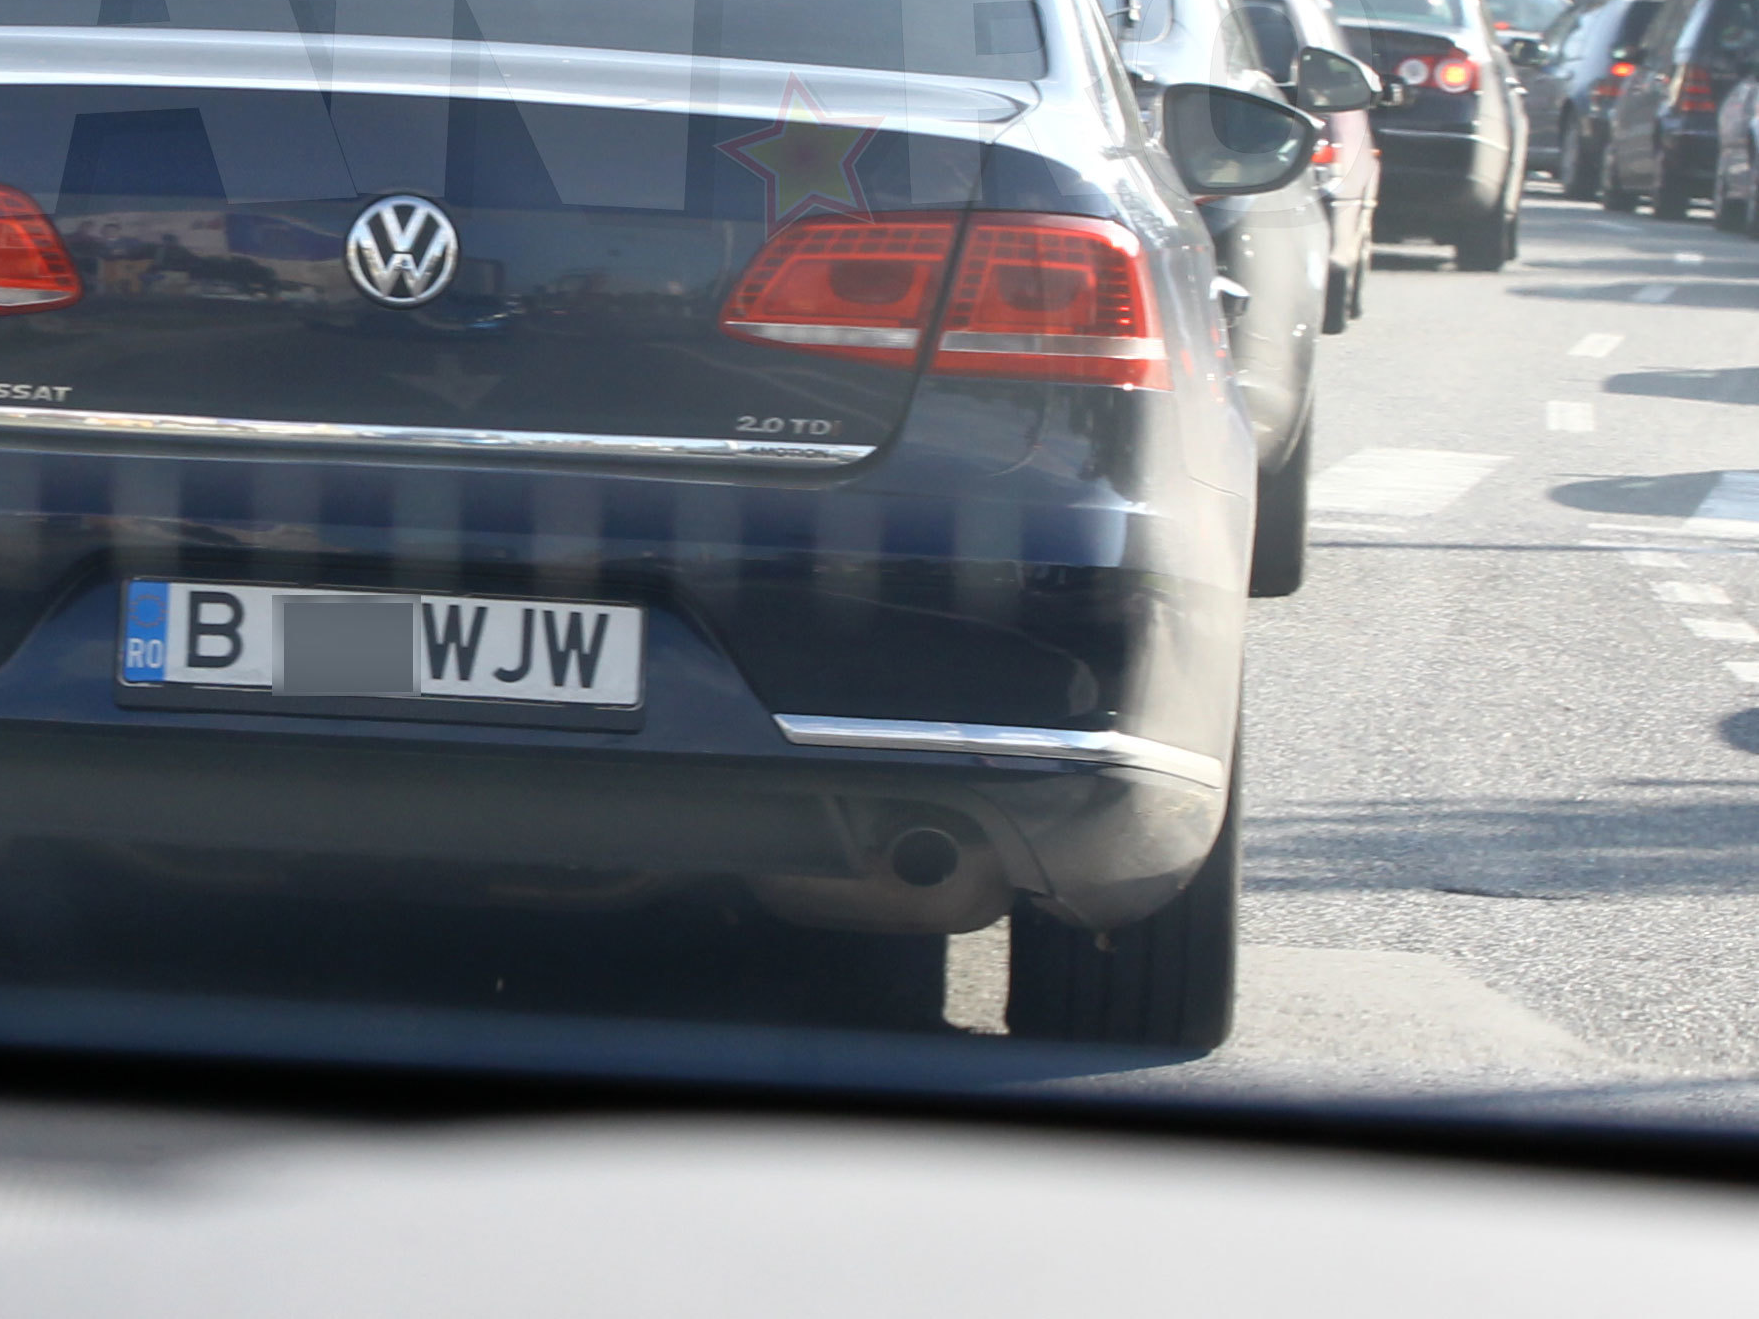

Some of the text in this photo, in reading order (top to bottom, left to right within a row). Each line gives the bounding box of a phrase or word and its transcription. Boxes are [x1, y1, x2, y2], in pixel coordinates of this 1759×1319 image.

[346, 194, 459, 303] VW
[735, 414, 786, 434] 2.0
[126, 636, 164, 670] RO
[186, 590, 610, 689] B WJW
